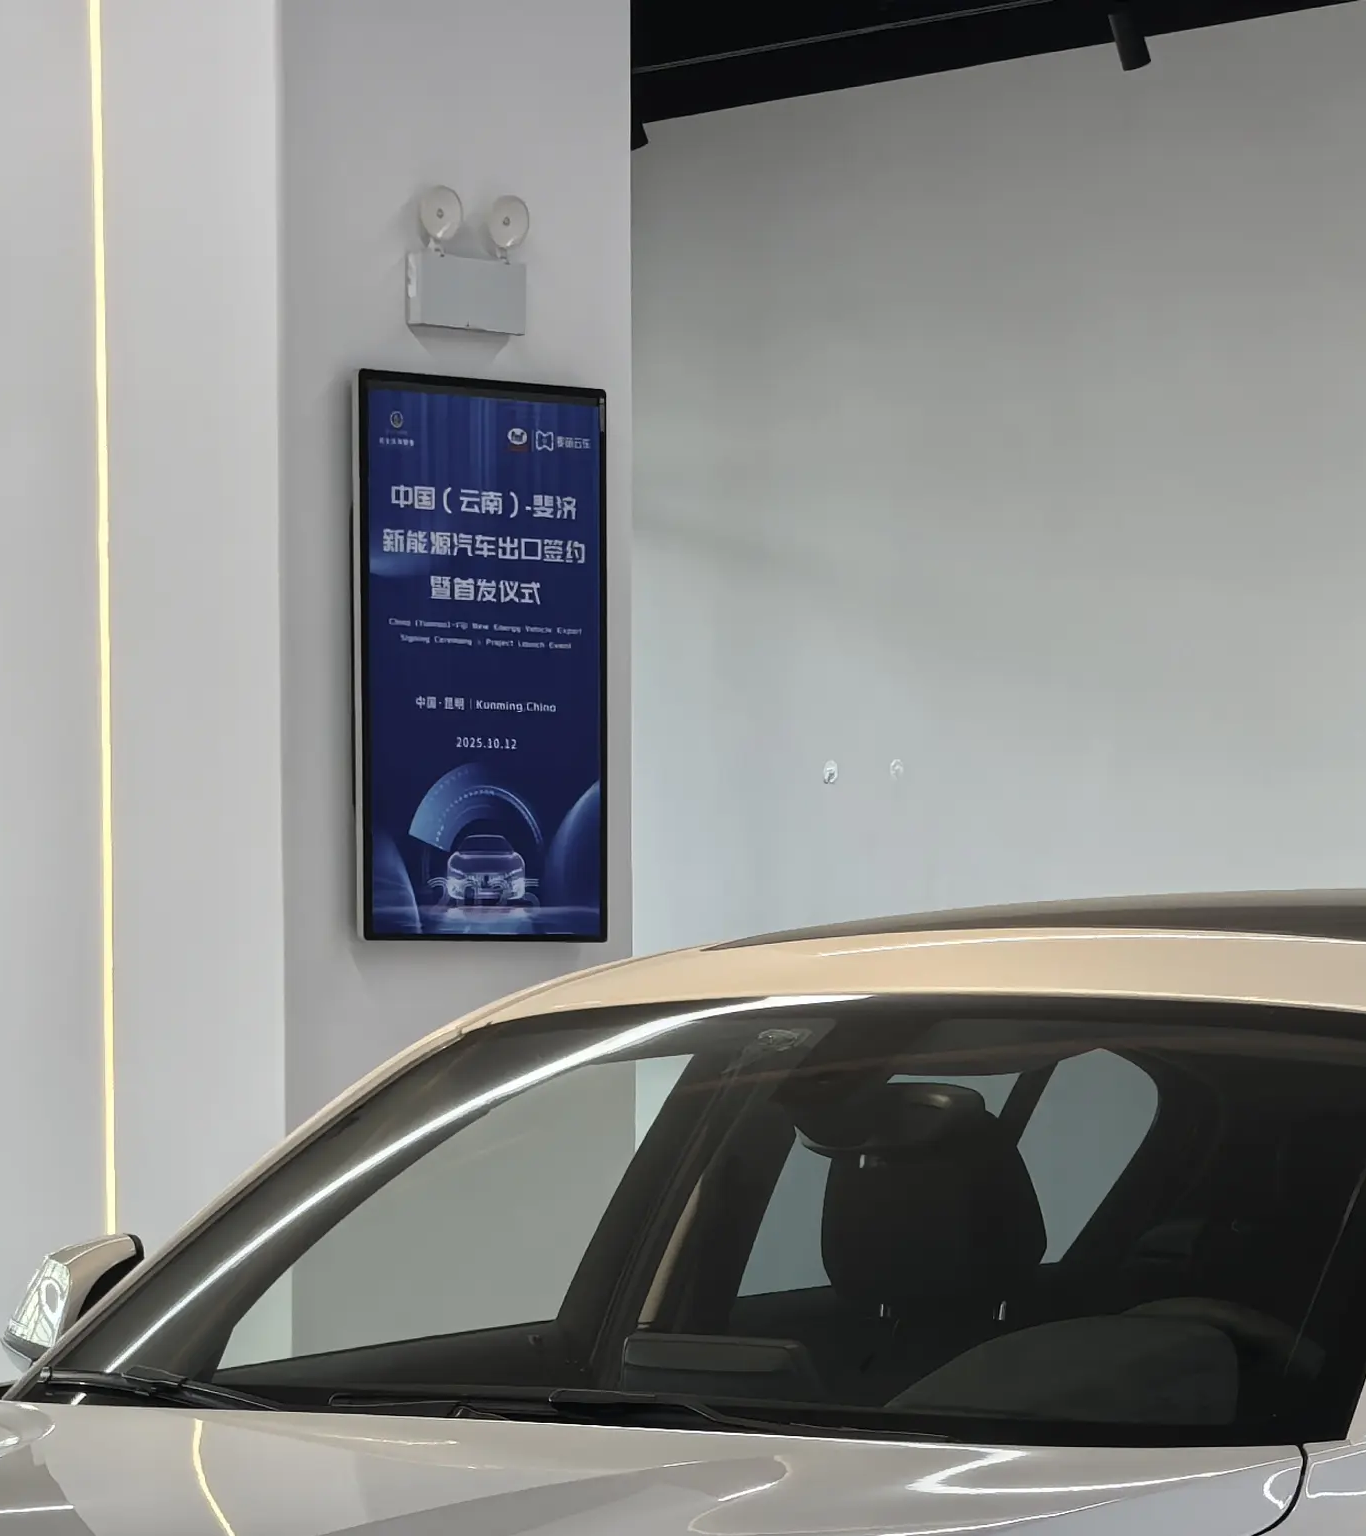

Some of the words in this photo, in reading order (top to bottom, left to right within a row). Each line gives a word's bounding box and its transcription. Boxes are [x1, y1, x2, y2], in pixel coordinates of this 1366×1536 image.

[382, 528, 586, 564] 新能源汽车出口签约
[430, 575, 541, 605] 暨首发仪式
[456, 736, 518, 750] 2025.10.12
